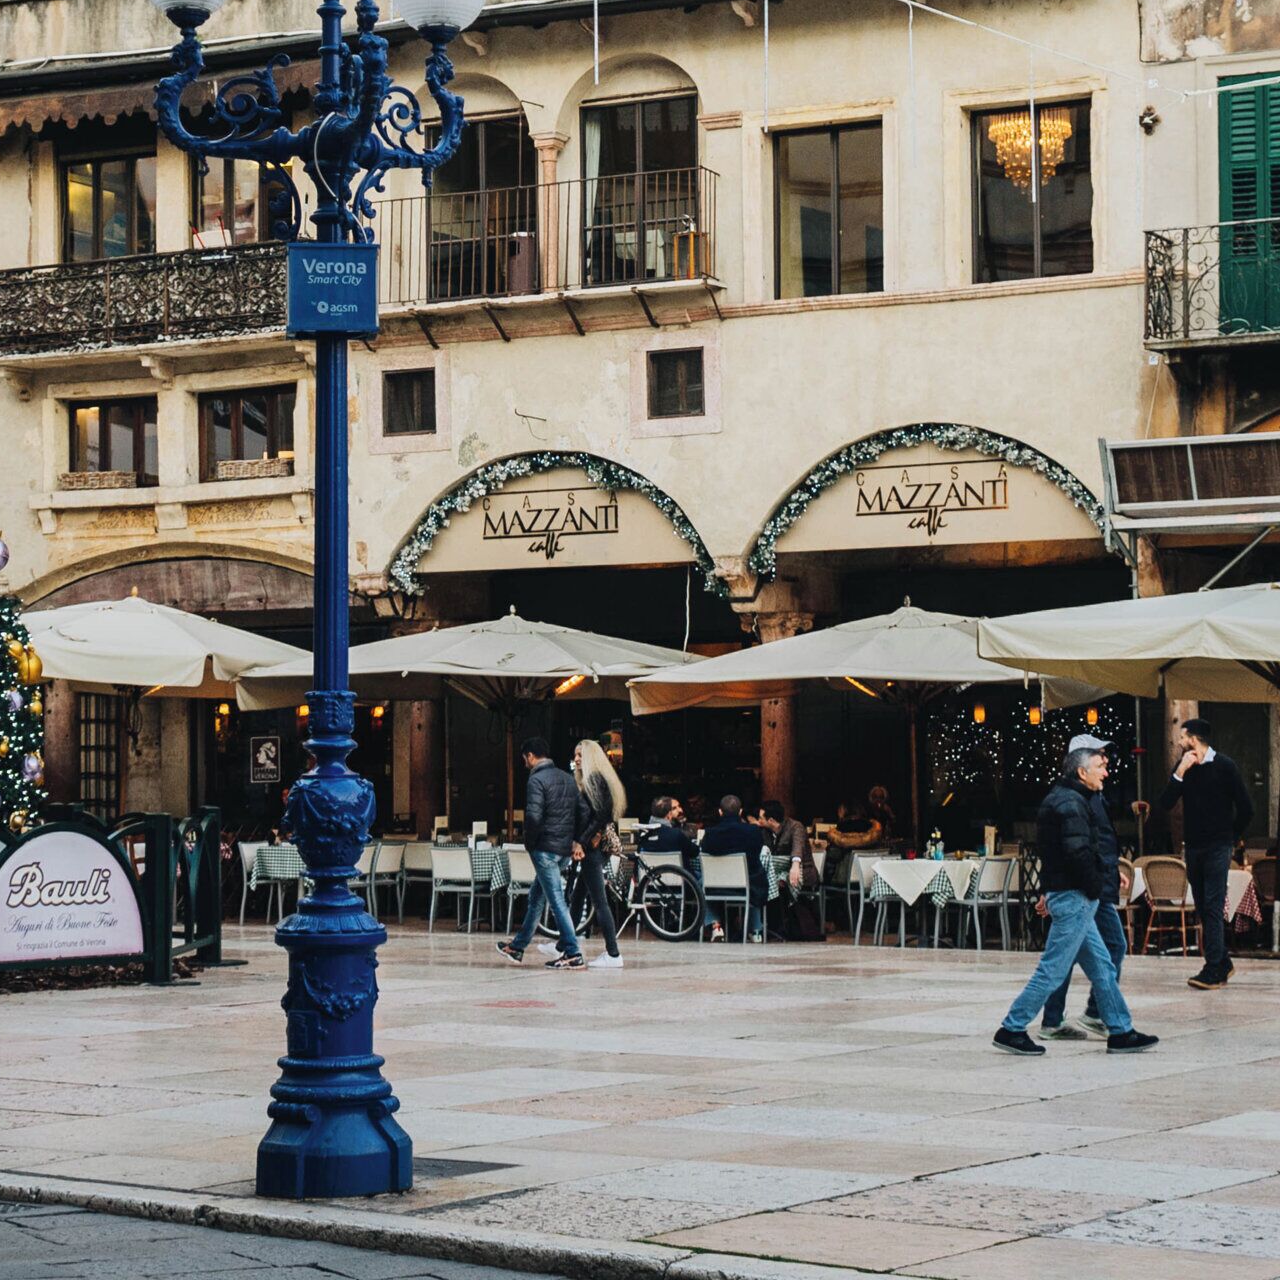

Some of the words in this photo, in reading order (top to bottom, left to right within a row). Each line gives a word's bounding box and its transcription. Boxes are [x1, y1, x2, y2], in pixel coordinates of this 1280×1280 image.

[302, 258, 367, 274] Verona
[307, 275, 339, 284] Smart
[341, 275, 362, 286] City
[856, 479, 1008, 513] MAZZANTI
[483, 505, 618, 536] MAZZANTI
[6, 861, 111, 908] Bauli
[4, 914, 42, 938] Auguri
[44, 917, 53, 931] di
[56, 913, 91, 931] Buone
[93, 911, 119, 928] Feste
[53, 940, 78, 949] Comune
[85, 939, 106, 947] Verona
